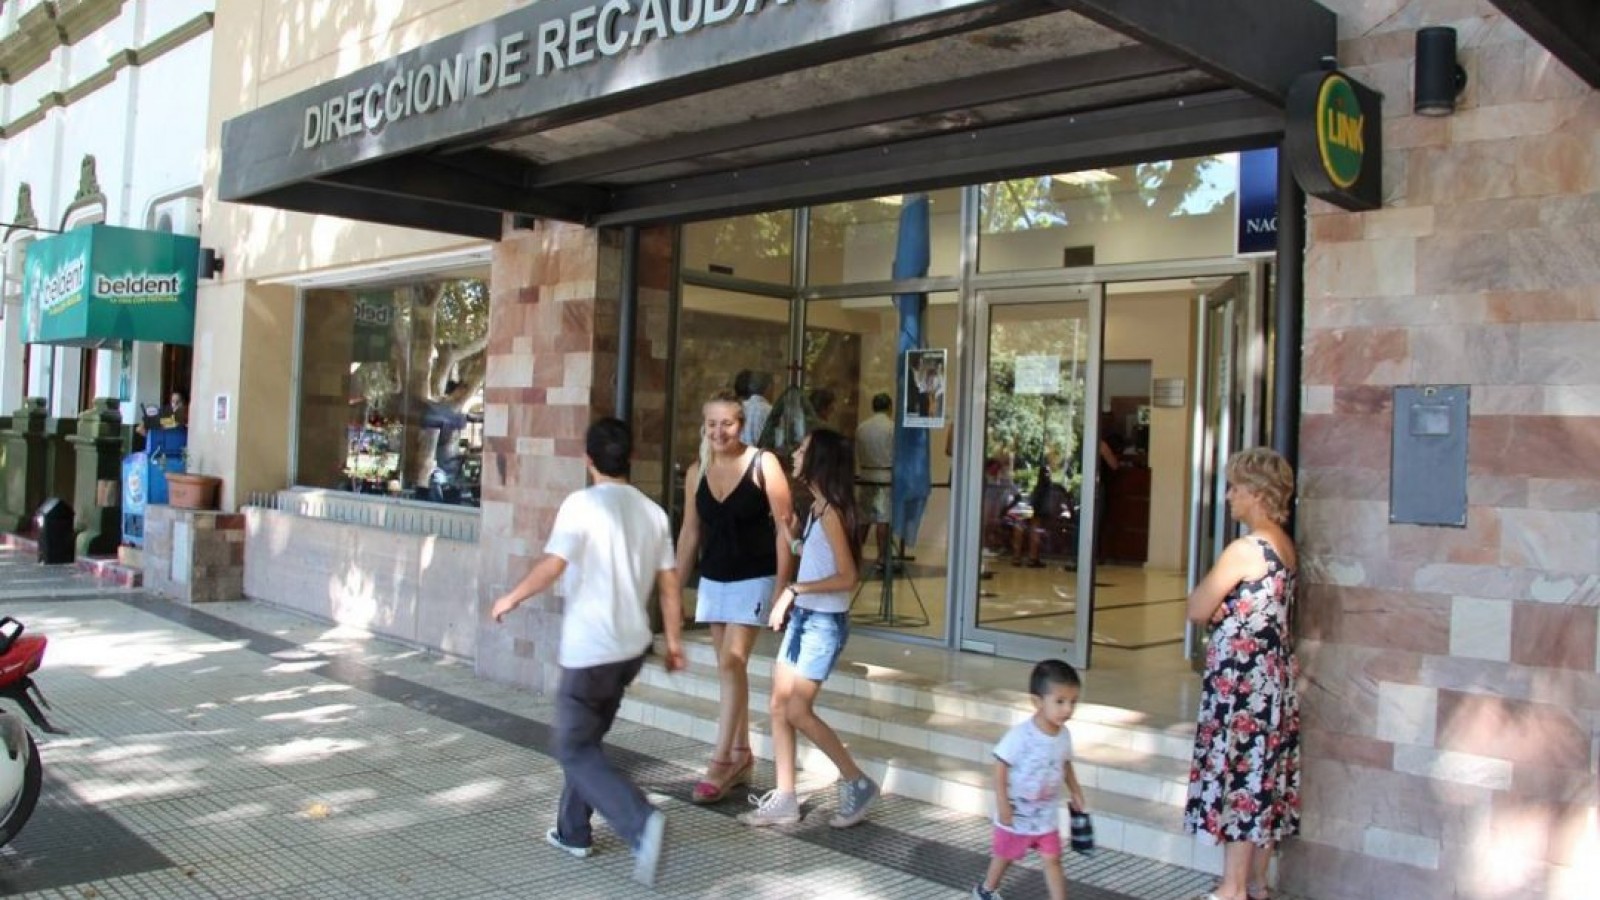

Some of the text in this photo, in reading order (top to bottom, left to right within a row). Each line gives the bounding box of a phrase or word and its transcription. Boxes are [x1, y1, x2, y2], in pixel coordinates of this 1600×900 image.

[303, 0, 790, 148] DIRECCION DE RECAUD
[1328, 108, 1364, 154] LINK
[44, 262, 84, 305] beldent
[98, 276, 178, 294] beldent
